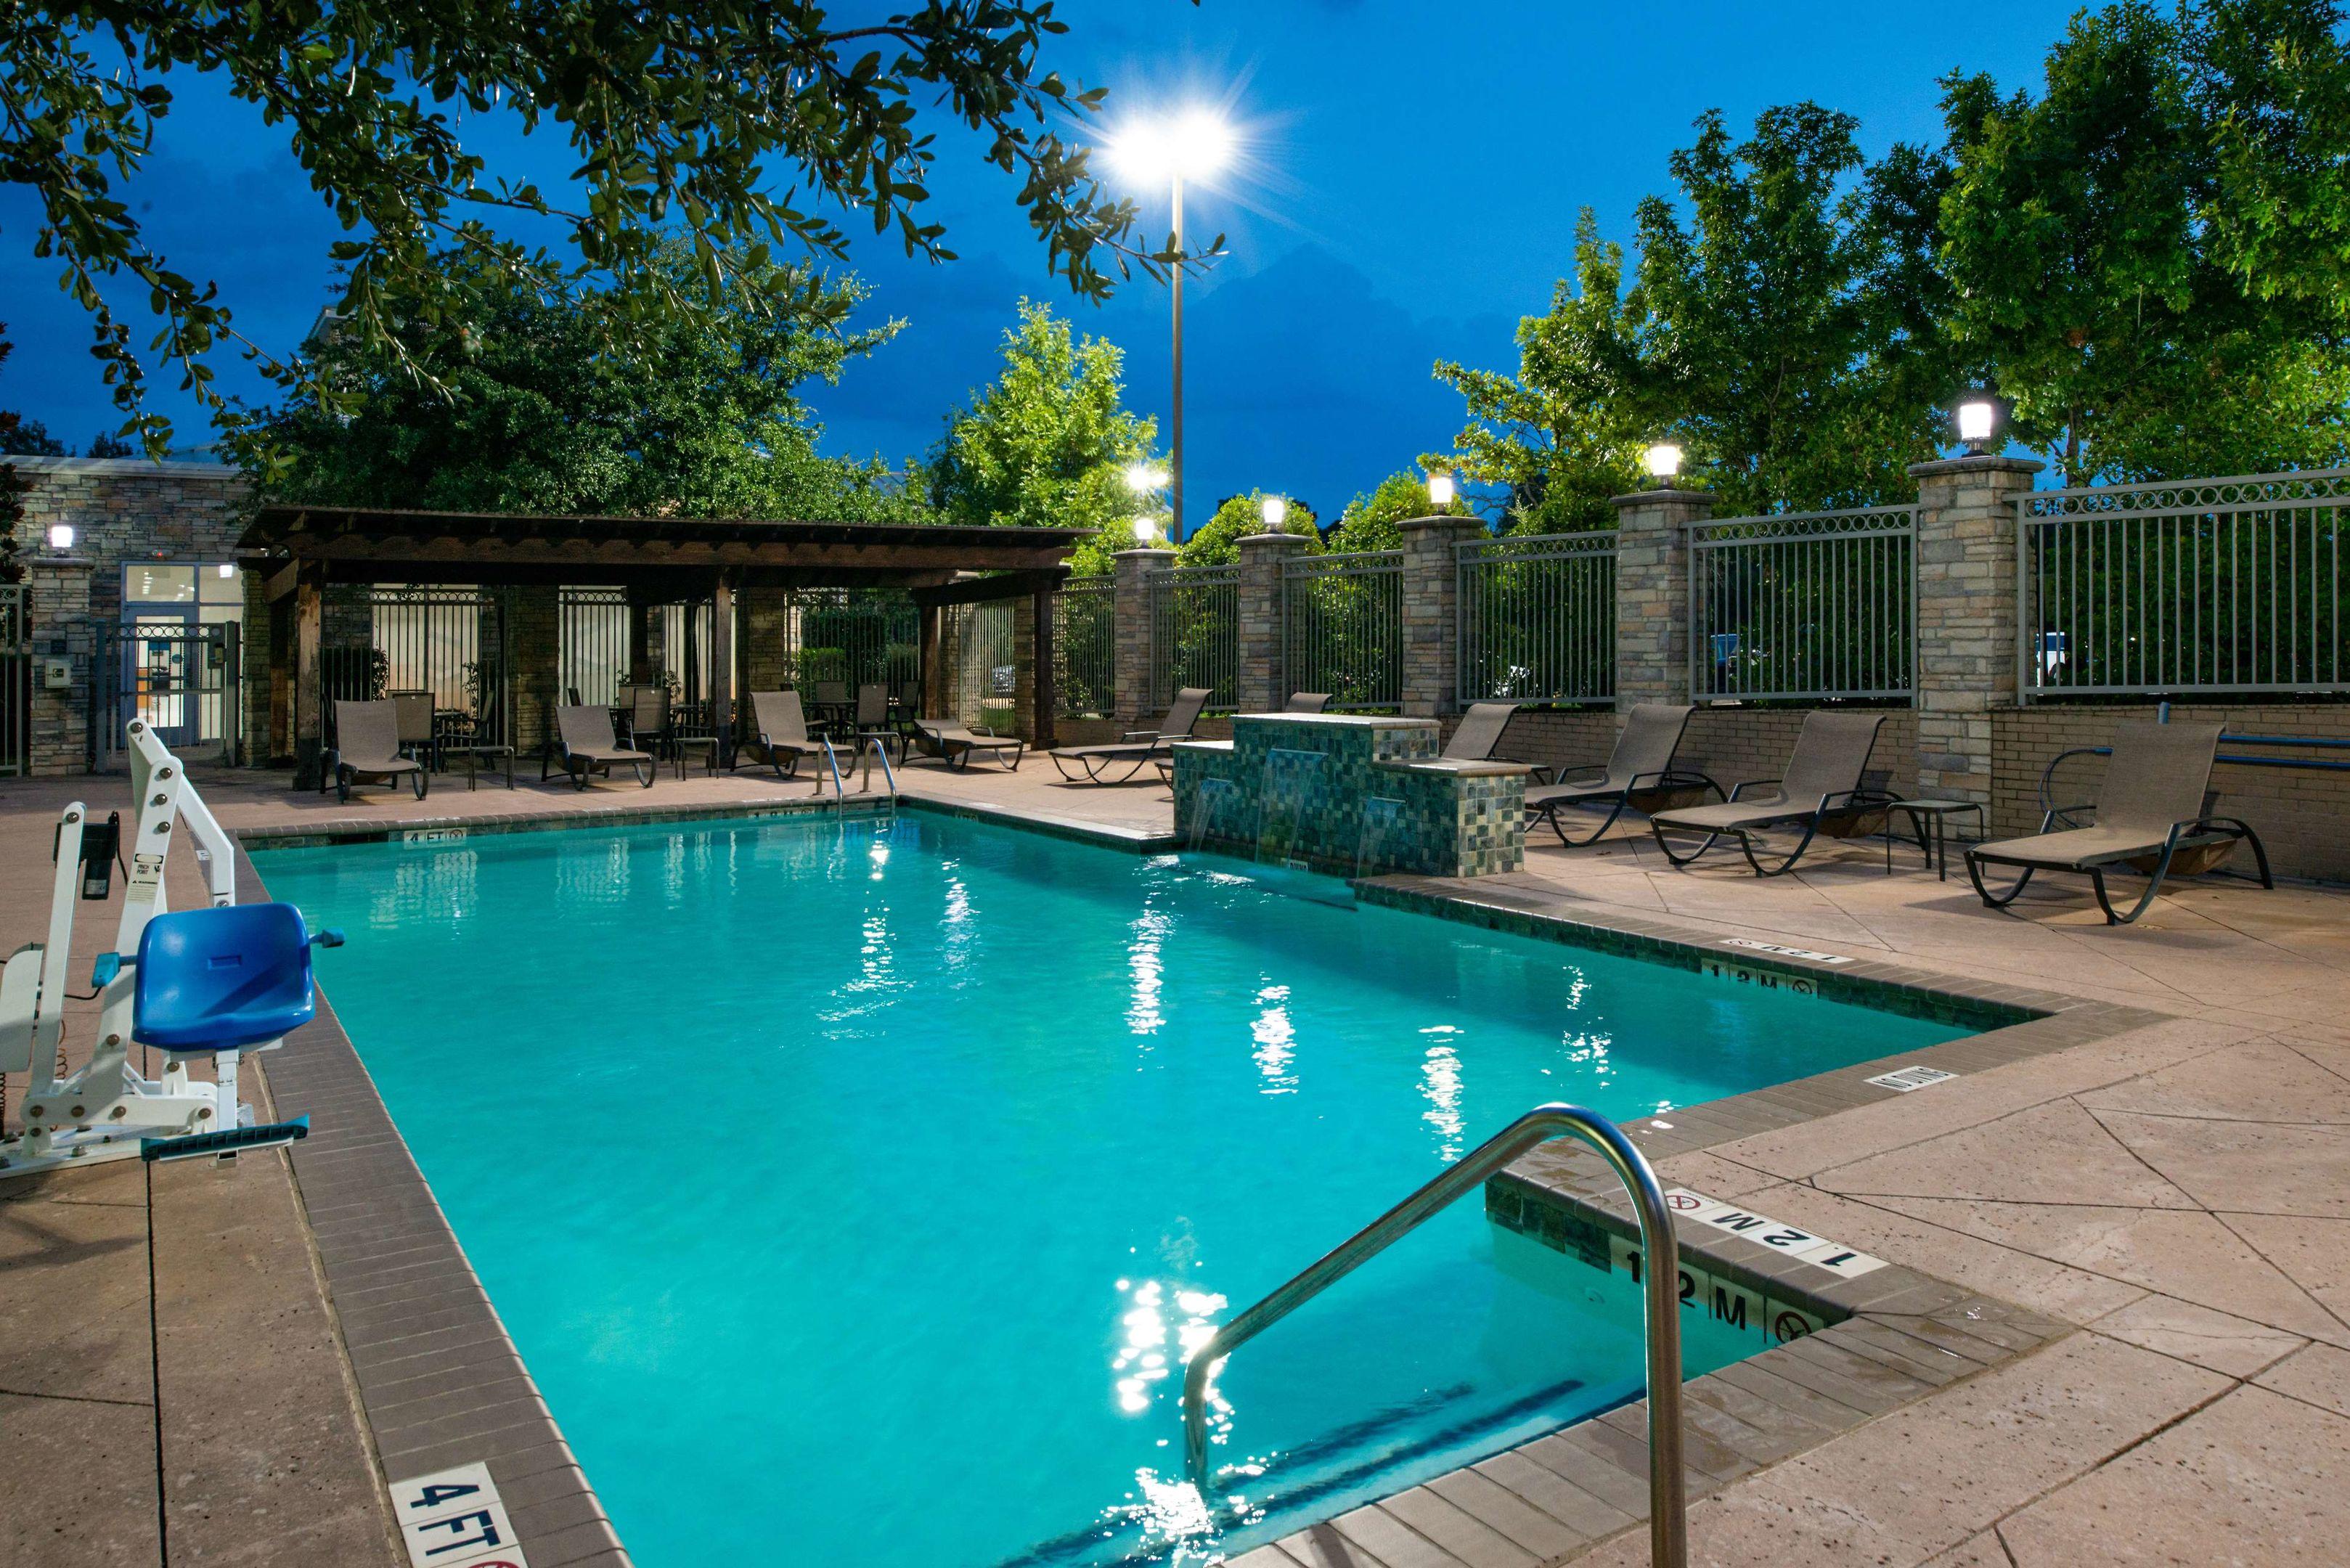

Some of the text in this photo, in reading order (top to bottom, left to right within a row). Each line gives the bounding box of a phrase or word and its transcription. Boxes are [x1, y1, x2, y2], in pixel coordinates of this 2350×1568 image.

[1715, 1286, 1746, 1331] M
[410, 1485, 501, 1556] 4 FT
